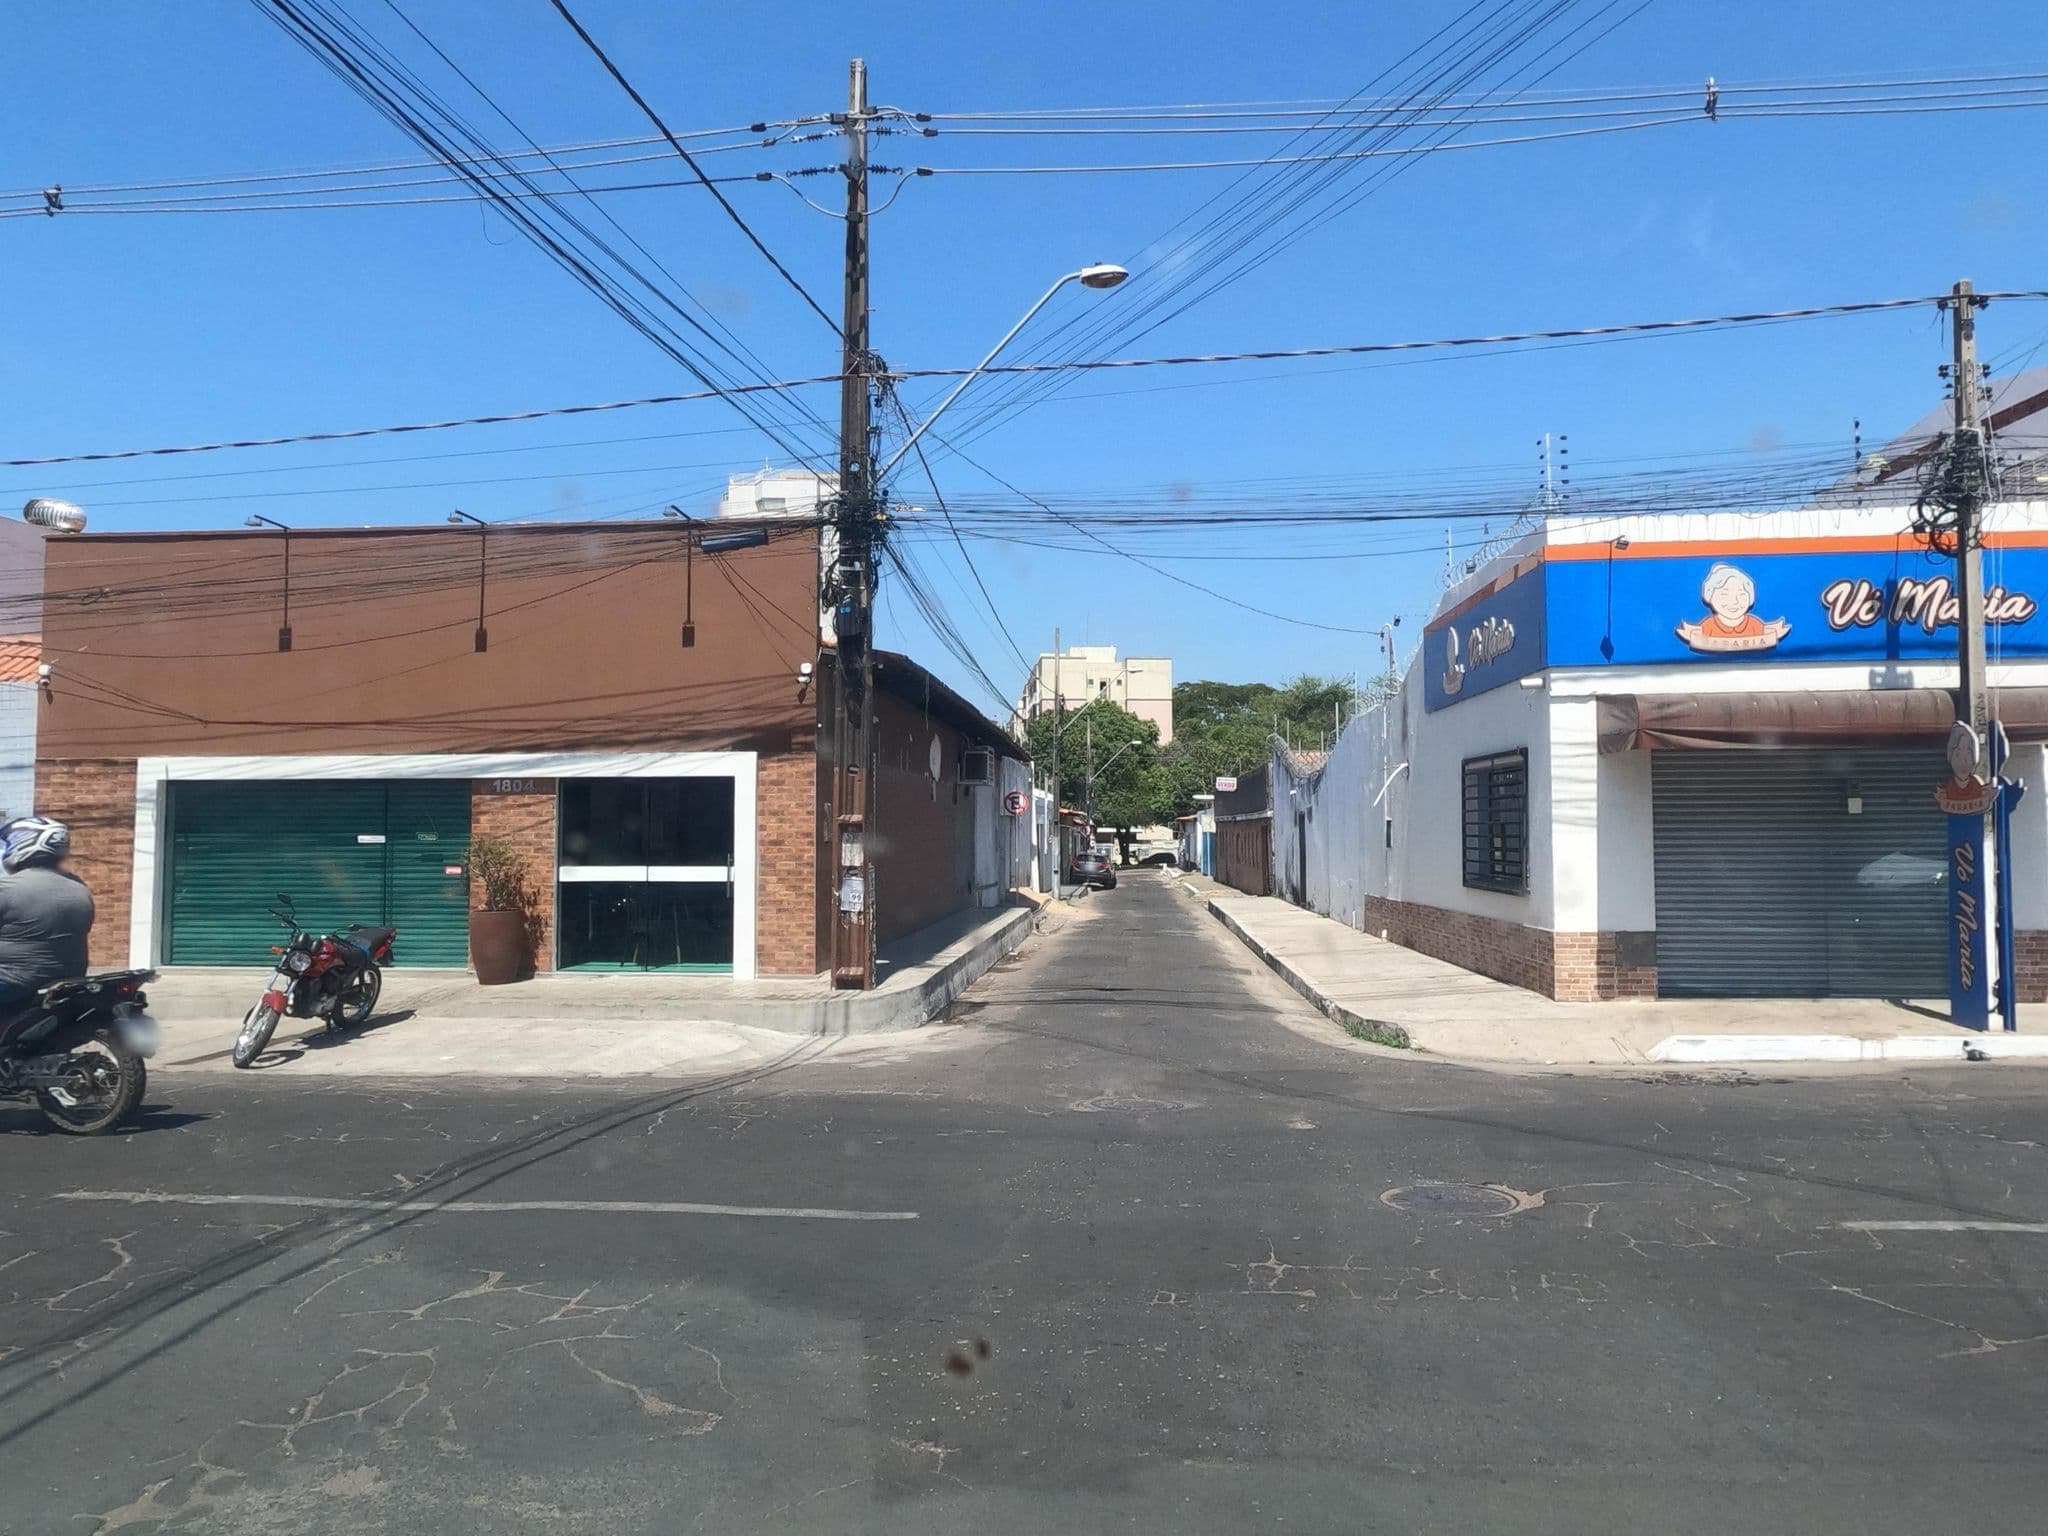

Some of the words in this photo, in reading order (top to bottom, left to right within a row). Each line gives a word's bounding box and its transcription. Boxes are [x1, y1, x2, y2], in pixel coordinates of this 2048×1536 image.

[1824, 580, 1882, 627] Vó
[1894, 577, 2036, 631] Maia
[492, 779, 536, 793] 1804
[1955, 843, 1975, 882] Vó
[1955, 888, 1979, 991] Maria
